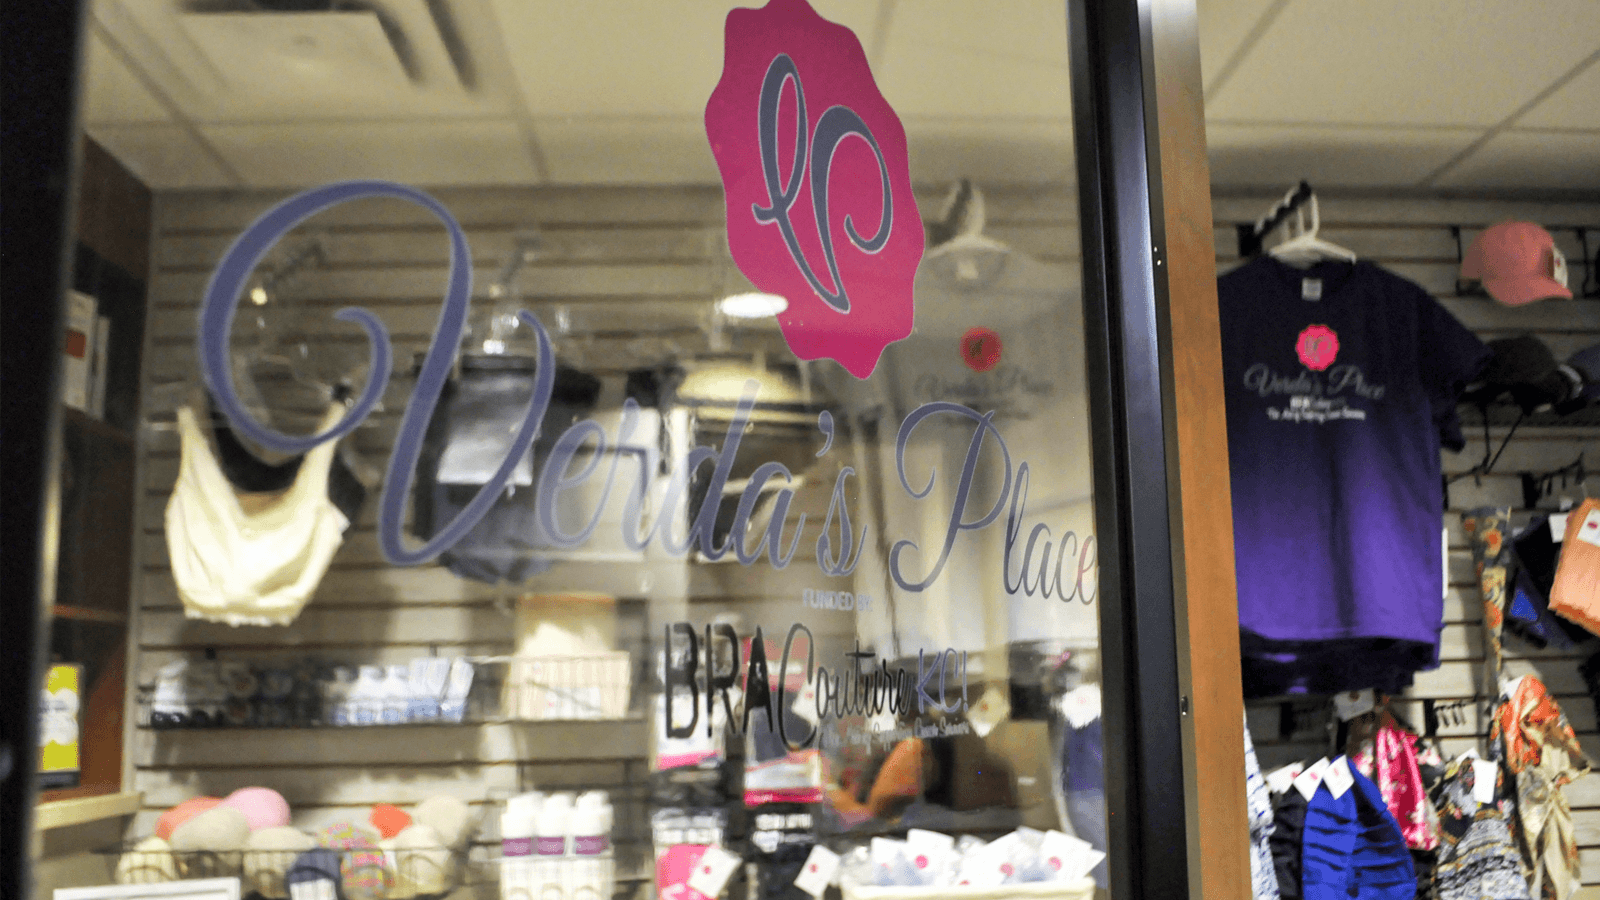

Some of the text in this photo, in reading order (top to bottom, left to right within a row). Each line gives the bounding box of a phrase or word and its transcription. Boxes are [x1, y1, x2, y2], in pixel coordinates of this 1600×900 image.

[199, 179, 1097, 606] Verda's Place
[802, 587, 855, 611] FUNDED
[915, 647, 969, 714] KC!
